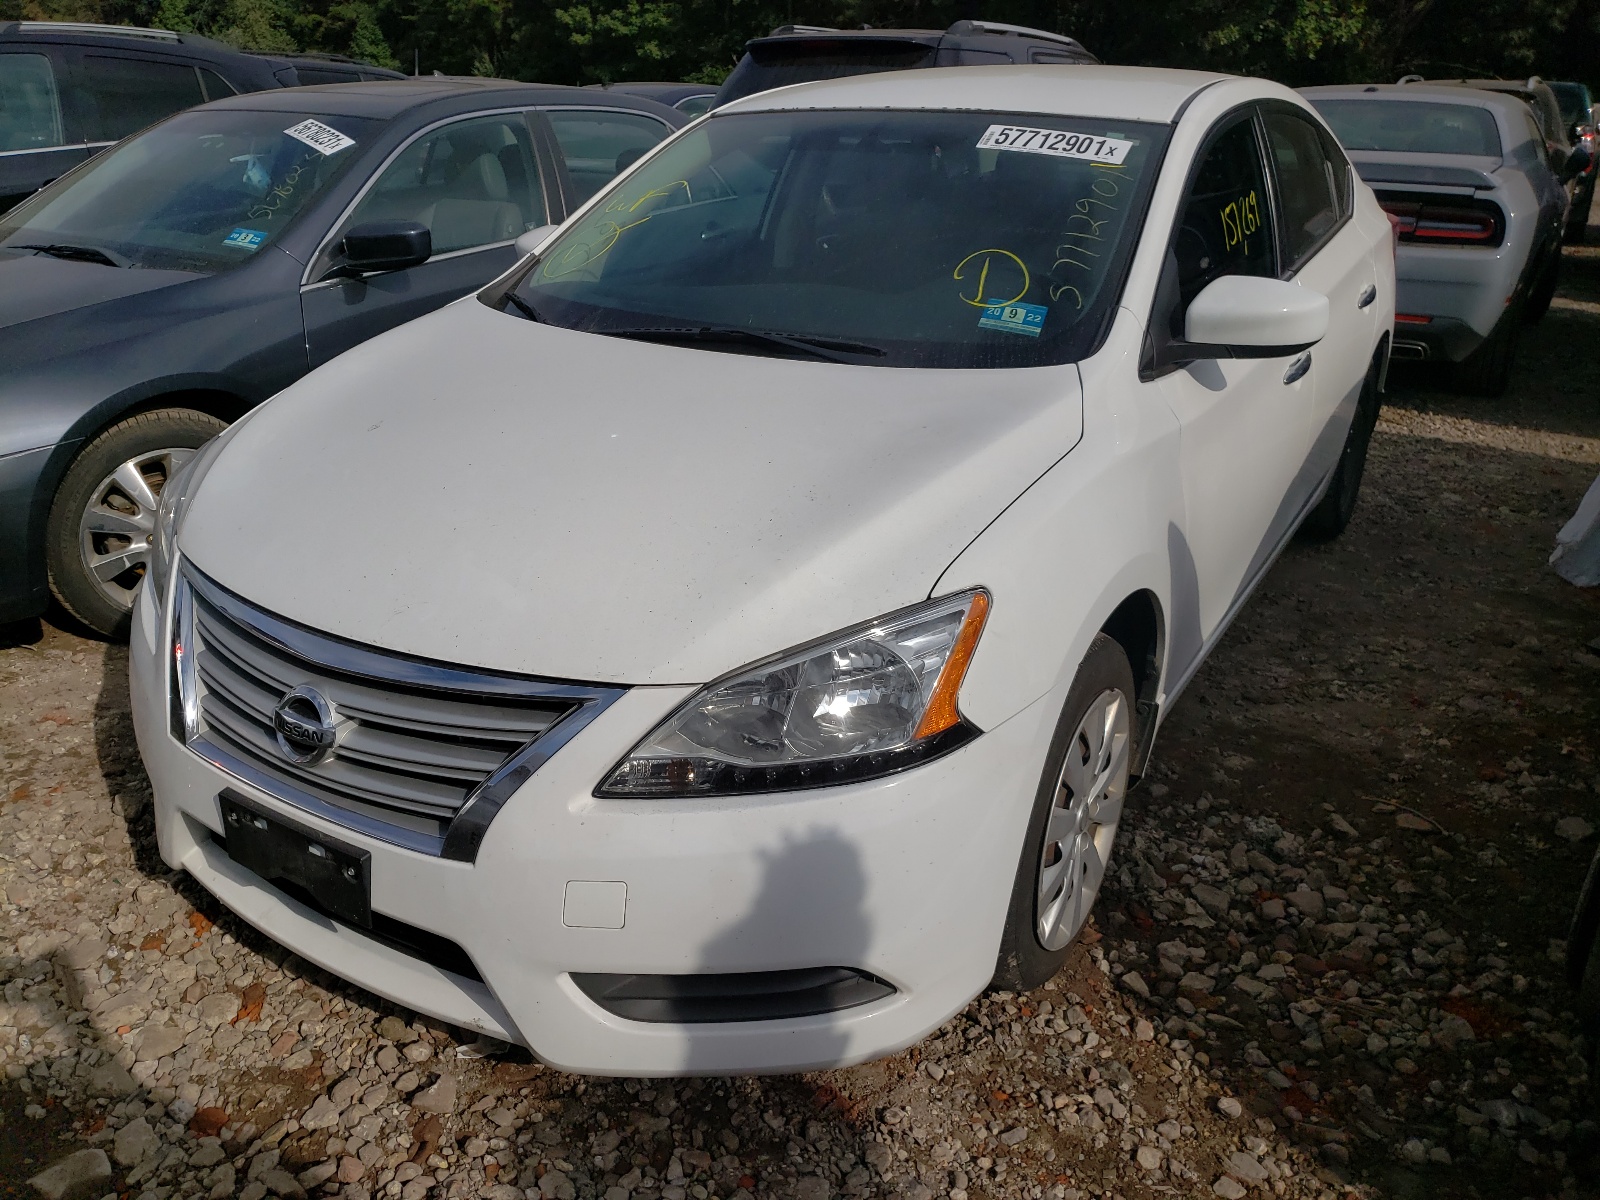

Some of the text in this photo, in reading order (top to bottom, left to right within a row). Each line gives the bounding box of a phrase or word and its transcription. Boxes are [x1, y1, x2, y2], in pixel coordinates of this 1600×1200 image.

[986, 307, 1042, 323] 20 9 22
